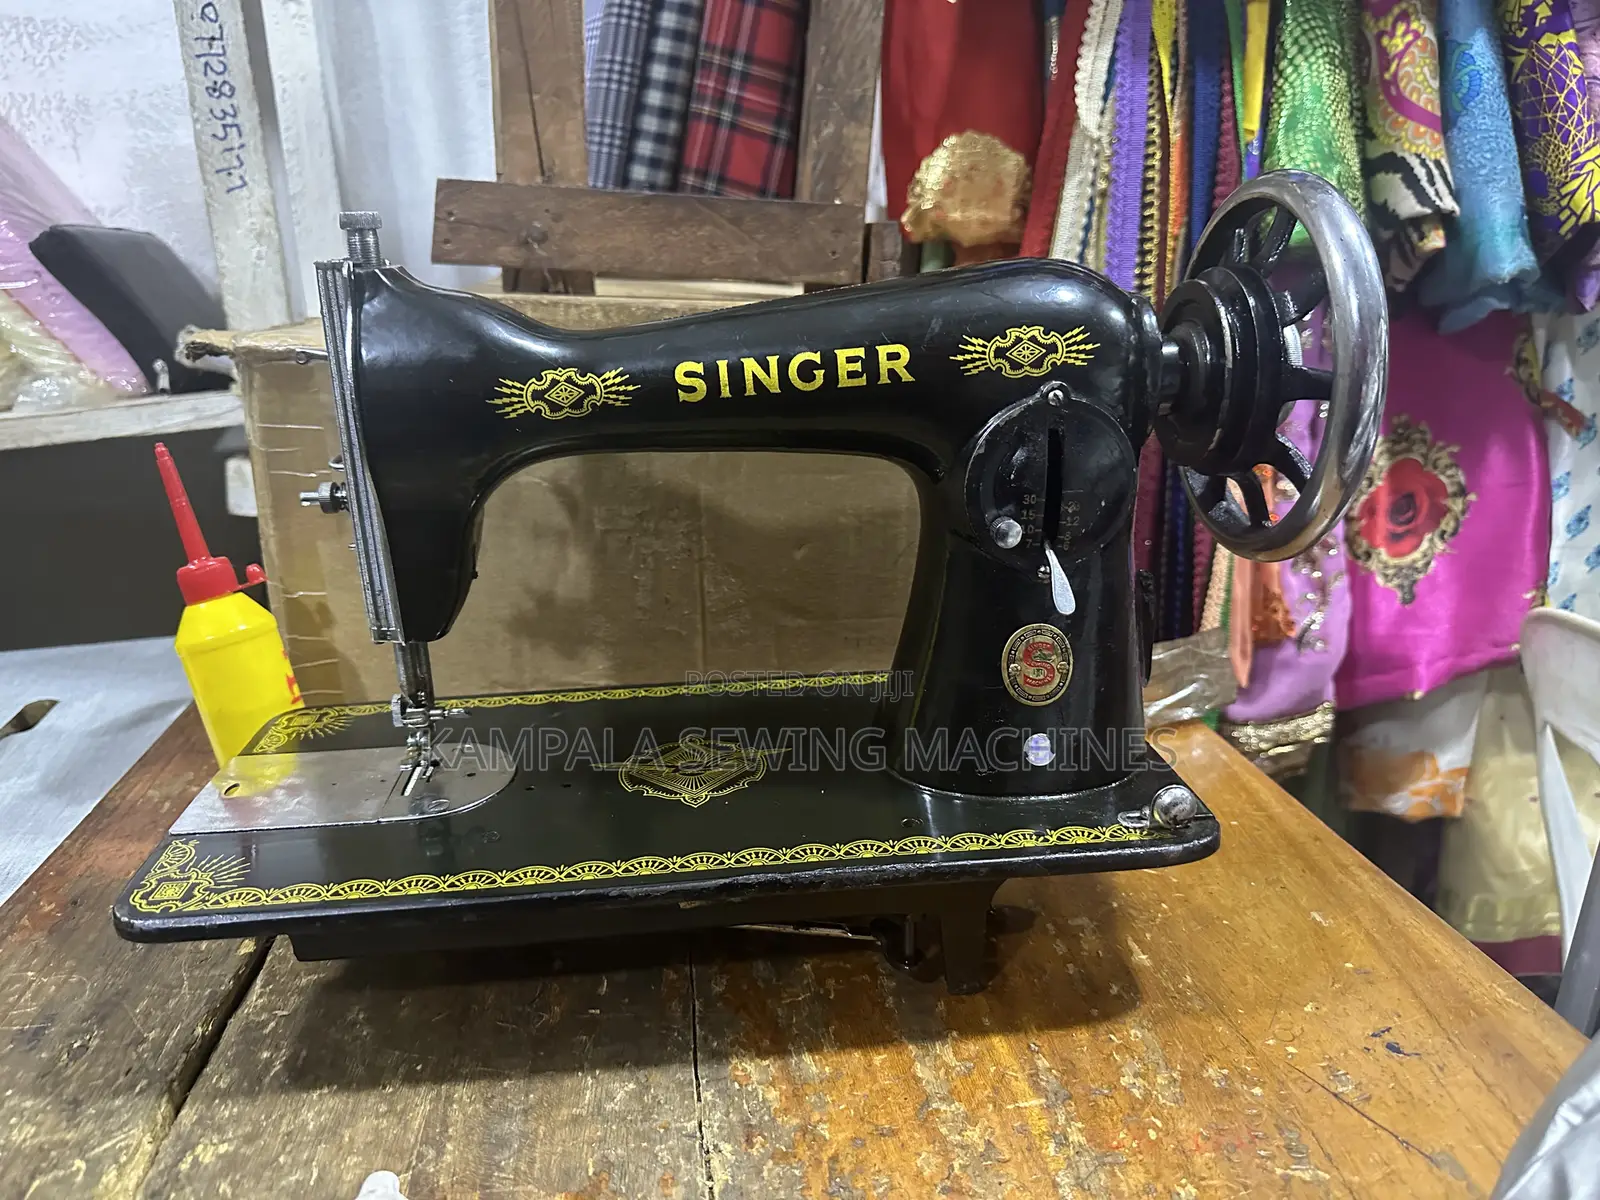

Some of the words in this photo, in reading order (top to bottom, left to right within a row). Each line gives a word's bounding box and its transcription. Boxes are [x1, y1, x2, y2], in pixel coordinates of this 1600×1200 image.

[674, 343, 915, 403] SINGER
[1022, 494, 1037, 505] 30
[1020, 509, 1036, 520] 15
[1065, 516, 1080, 526] 12
